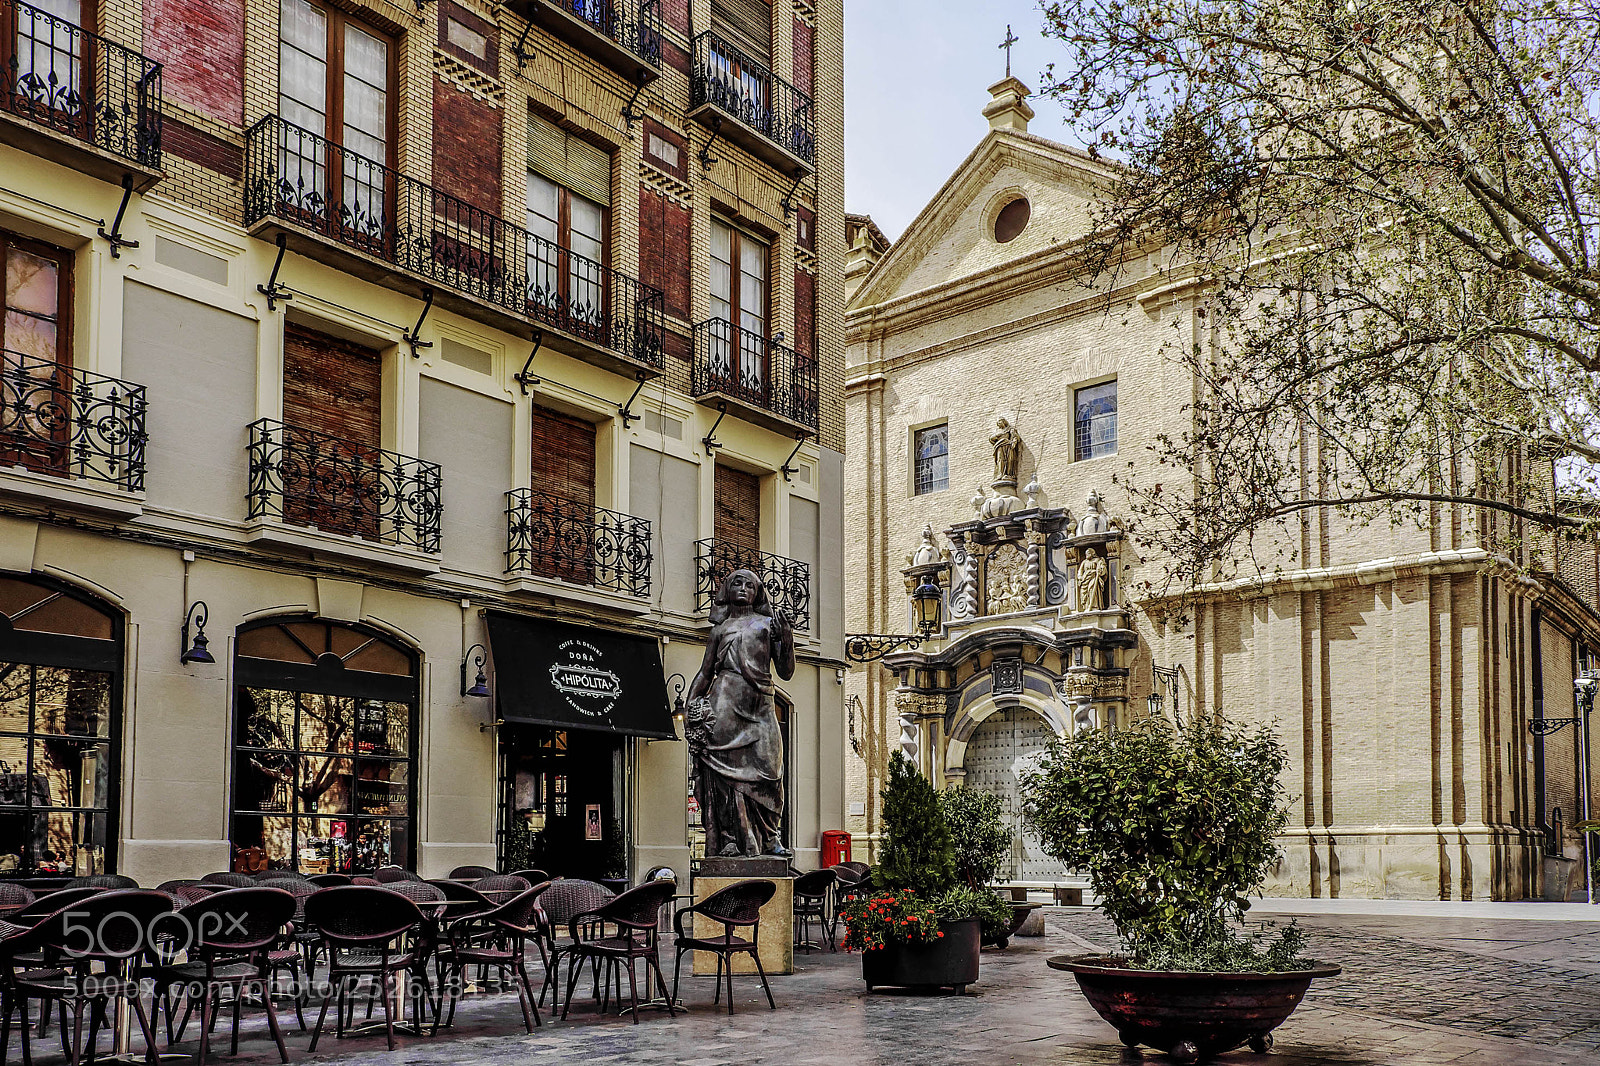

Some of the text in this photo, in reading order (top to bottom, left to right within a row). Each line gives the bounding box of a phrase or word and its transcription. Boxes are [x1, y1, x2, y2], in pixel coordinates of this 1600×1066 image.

[582, 641, 603, 657] DRINKS
[564, 673, 610, 690] HIPÓLITA
[565, 696, 595, 717] SANDWICH
[603, 701, 615, 713] CAKE
